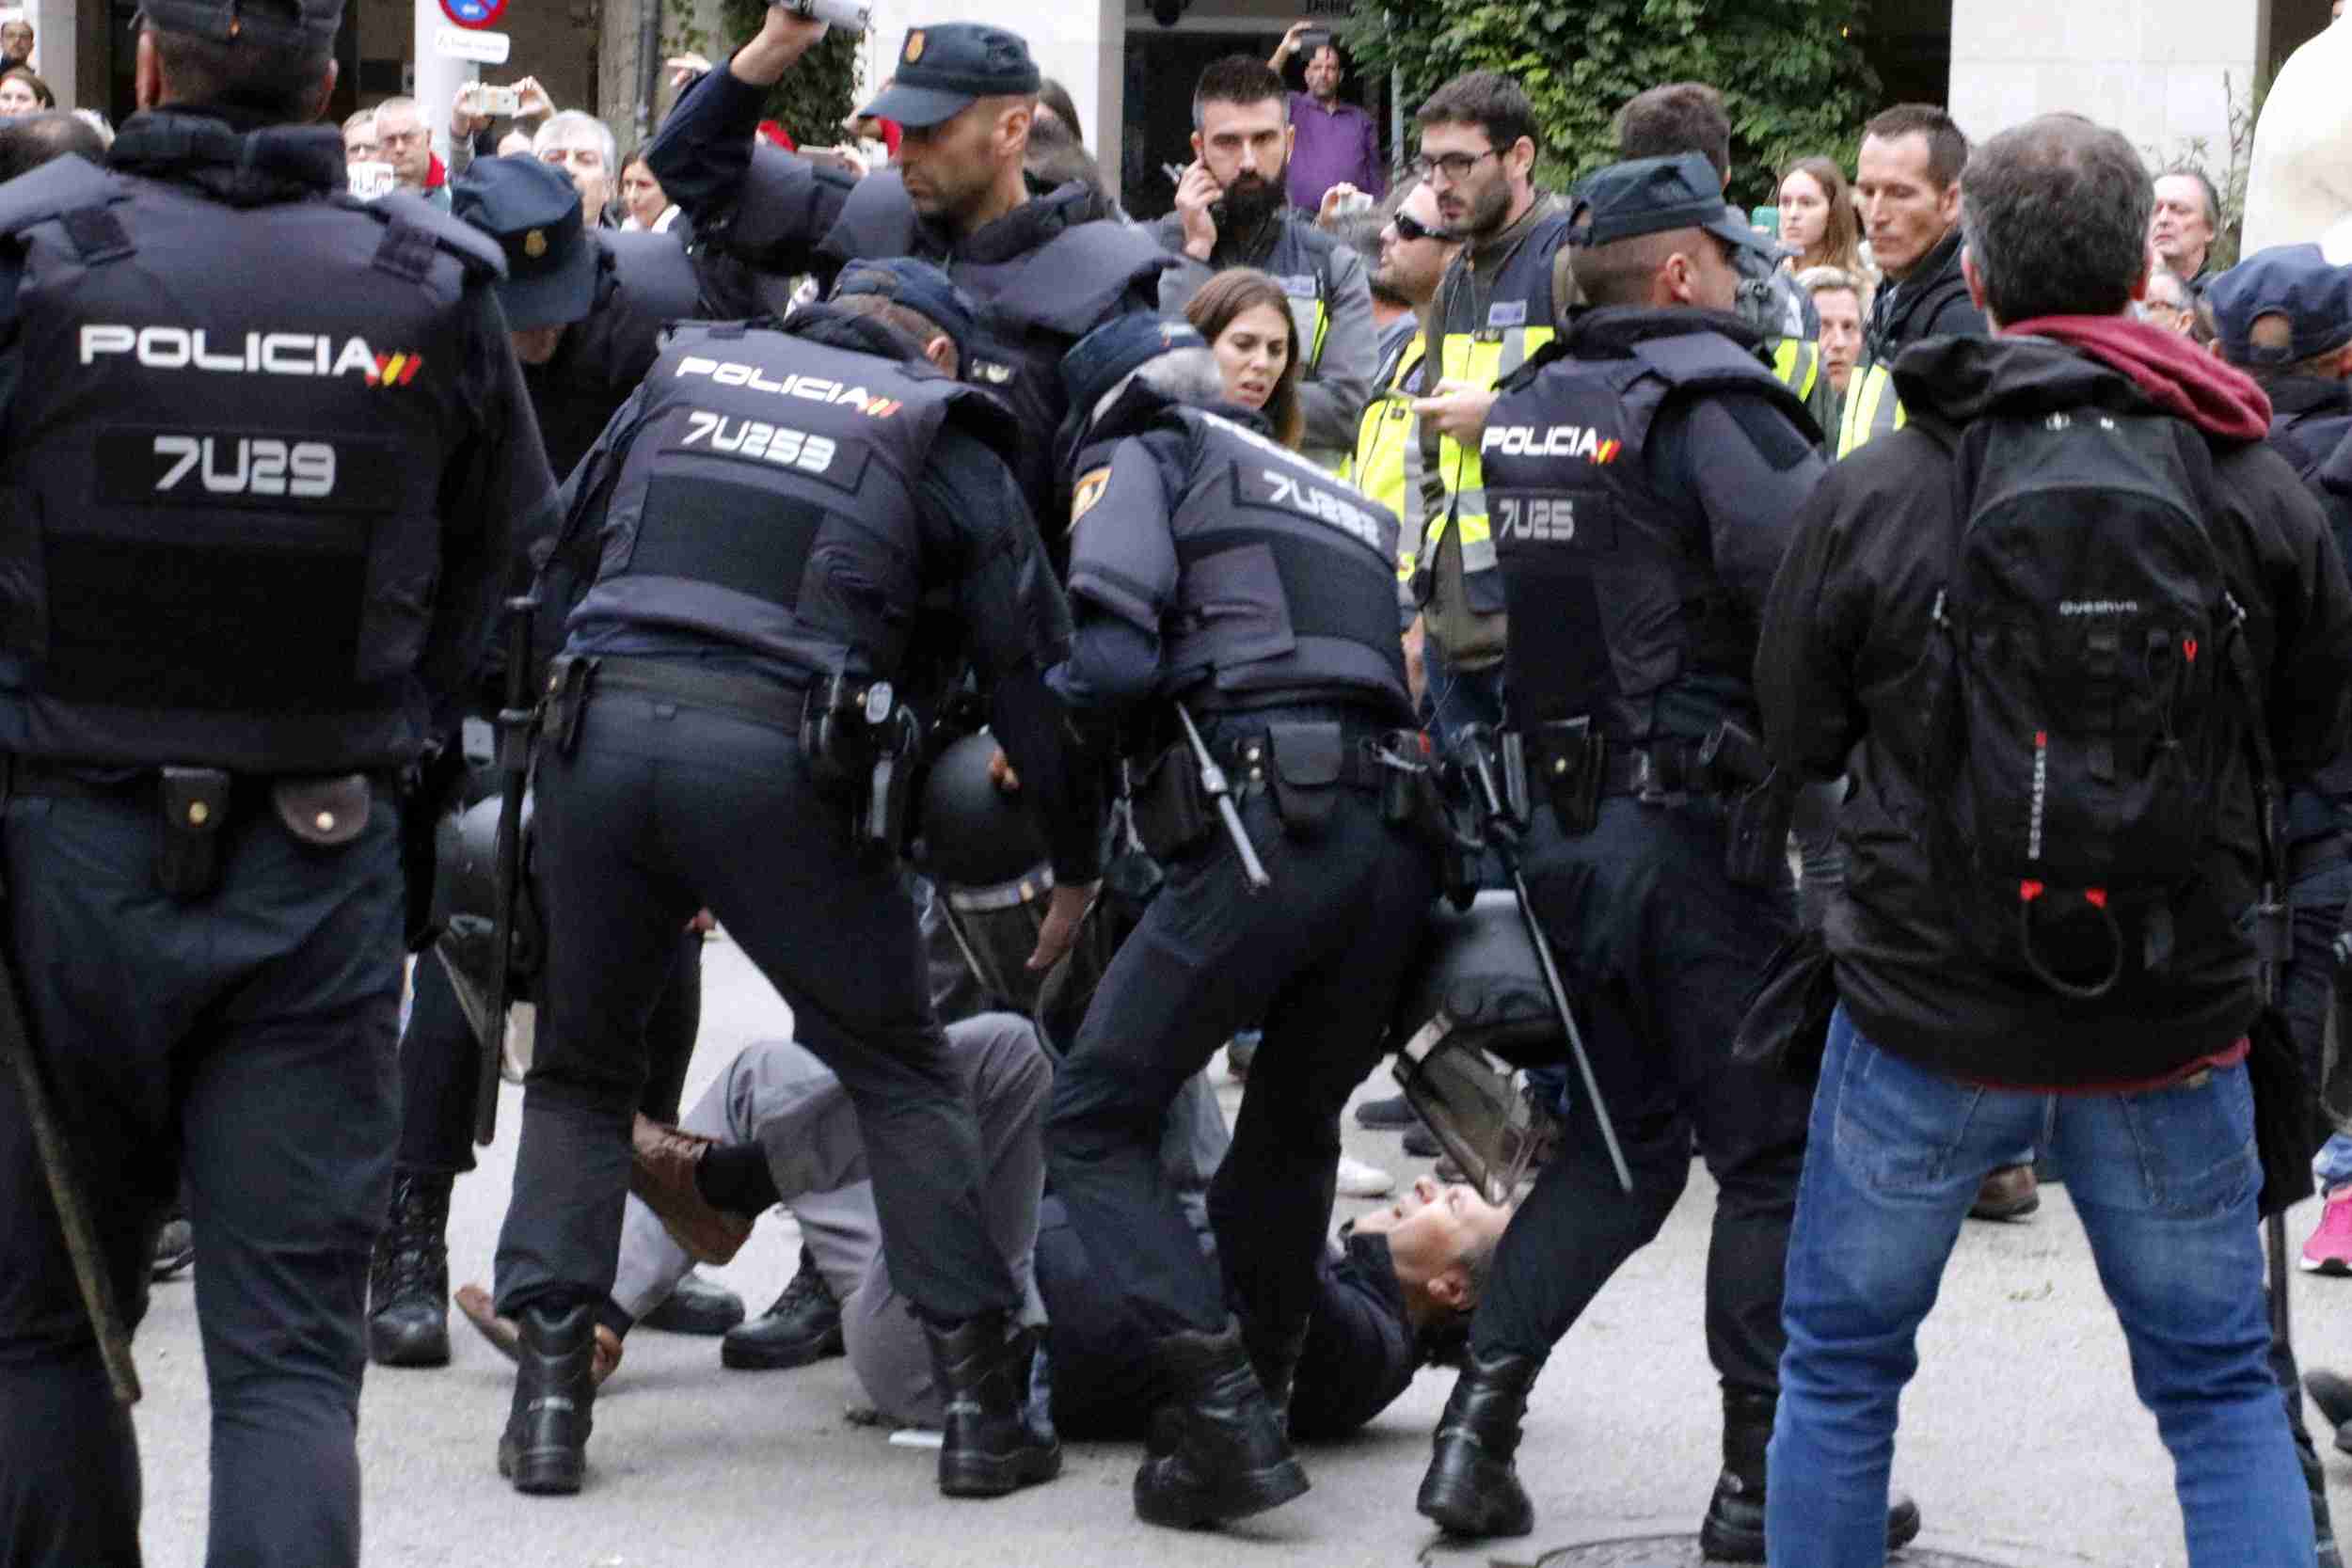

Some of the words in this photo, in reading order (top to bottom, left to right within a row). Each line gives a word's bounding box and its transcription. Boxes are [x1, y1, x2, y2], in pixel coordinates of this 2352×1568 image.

[79, 324, 380, 376] POLICIA
[675, 356, 868, 410] POLICIA
[152, 436, 336, 497] 7U29
[681, 410, 836, 473] 7U253
[1481, 426, 1597, 457] POLICIA
[1499, 499, 1574, 541] 7U25
